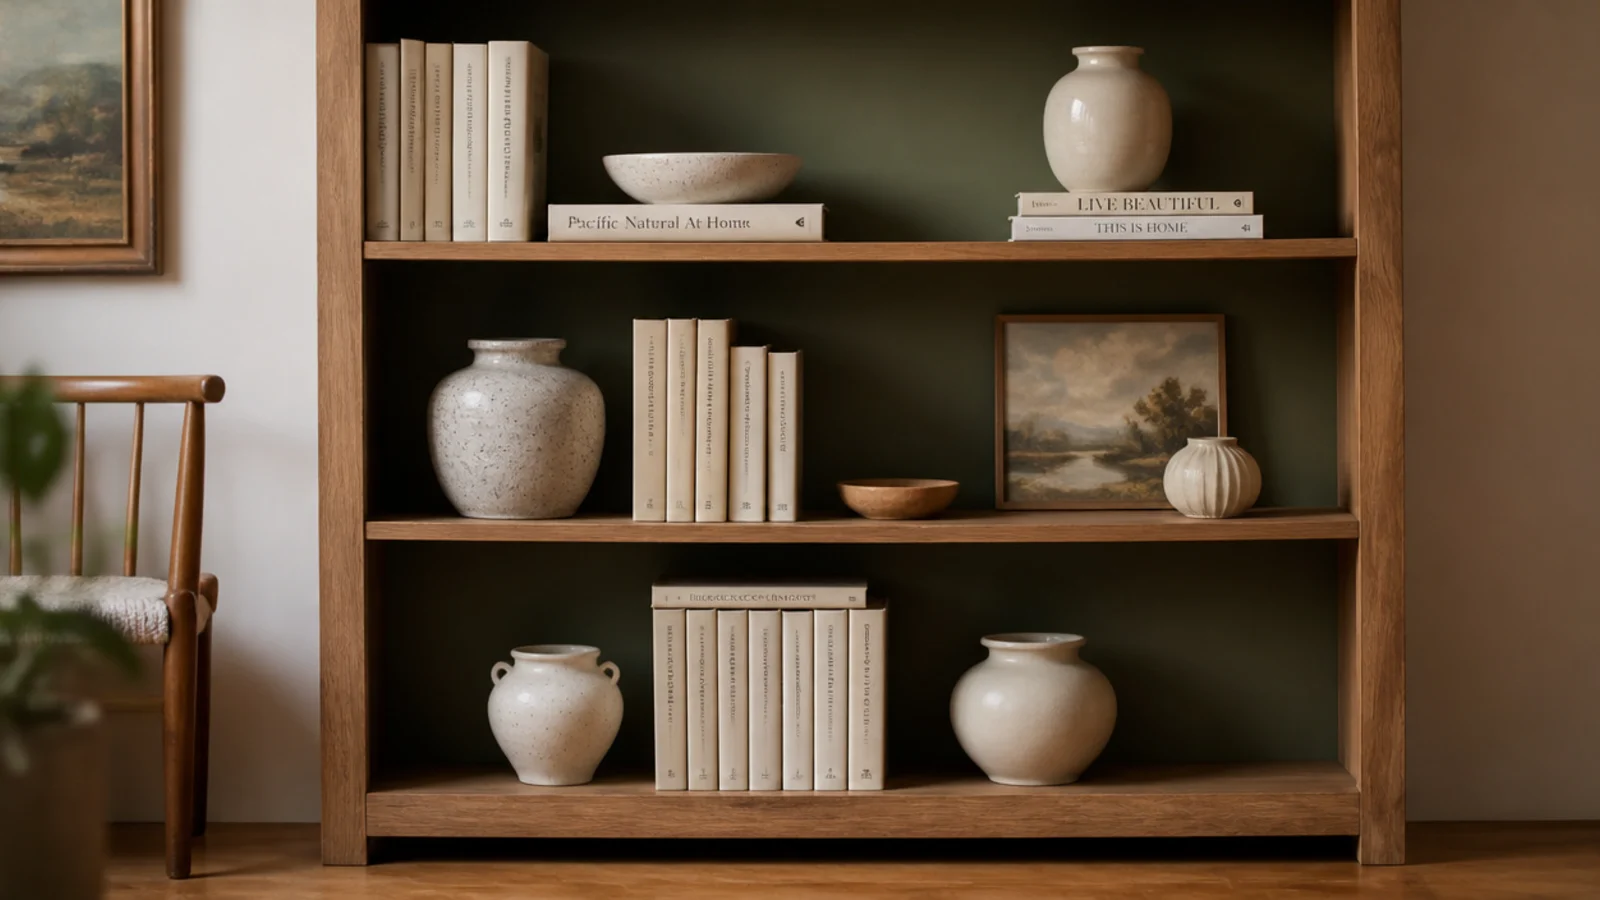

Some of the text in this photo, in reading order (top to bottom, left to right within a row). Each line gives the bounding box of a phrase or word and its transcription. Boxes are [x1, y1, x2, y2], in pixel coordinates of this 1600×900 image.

[1123, 197, 1220, 211] BEAUTIFUL
[625, 215, 680, 229] Natural
[685, 215, 702, 229] At
[1094, 222, 1188, 234] THIS IS HOME
